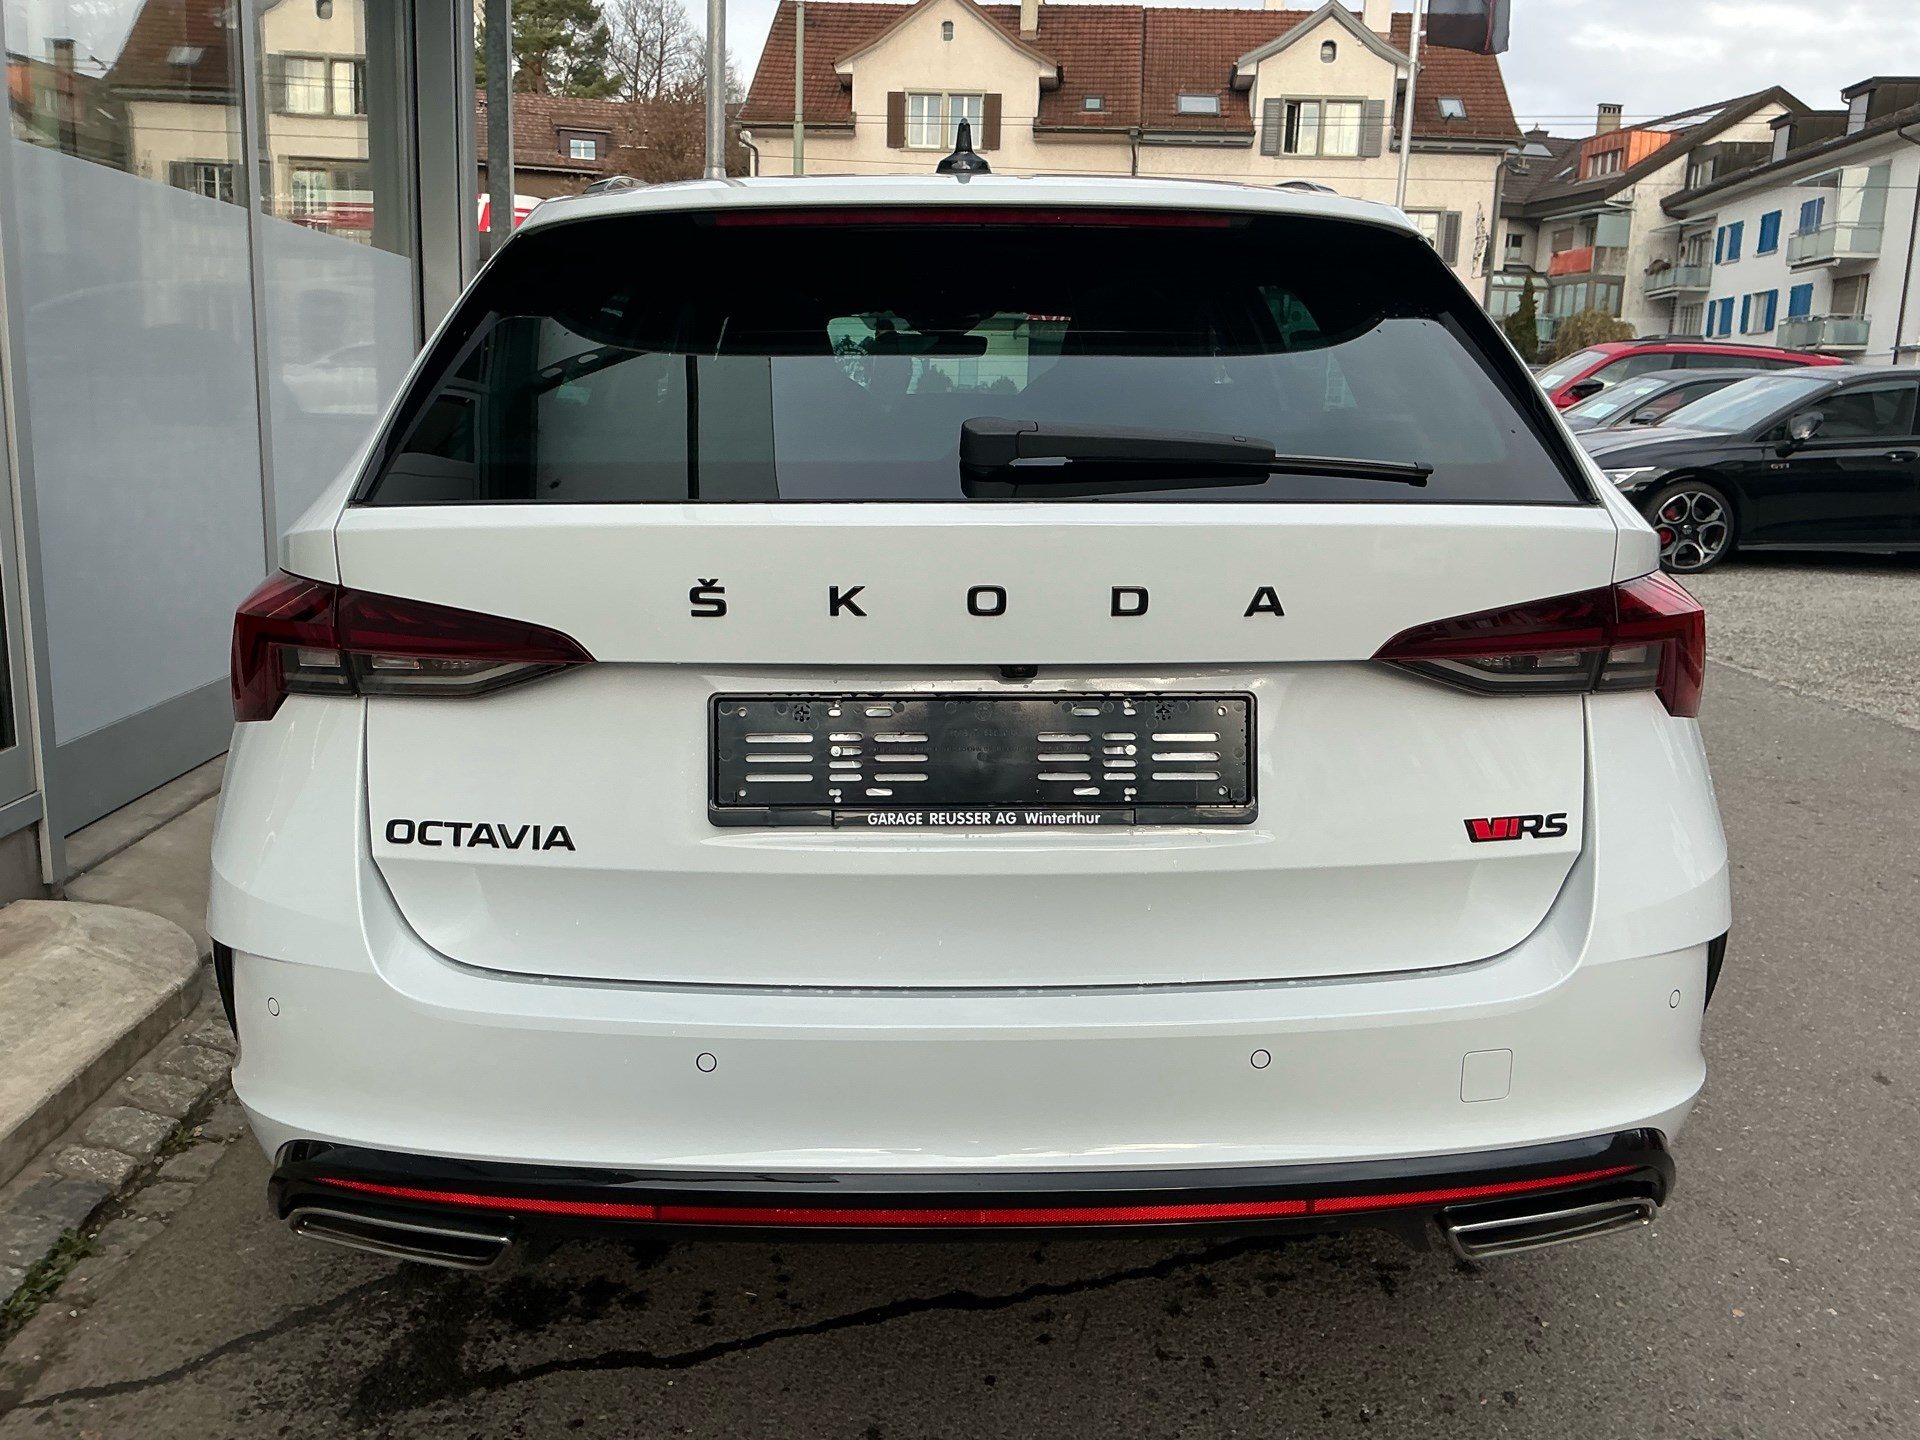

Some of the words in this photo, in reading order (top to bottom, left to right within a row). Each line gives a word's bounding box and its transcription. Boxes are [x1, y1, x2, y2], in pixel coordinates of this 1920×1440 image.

[688, 578, 1286, 618] ŠKODA
[385, 818, 577, 851] OCTAVIA
[867, 812, 923, 825] GARAGE
[929, 812, 991, 825] REUSSER
[995, 812, 1017, 825] AG
[1024, 812, 1101, 825] Winterthur
